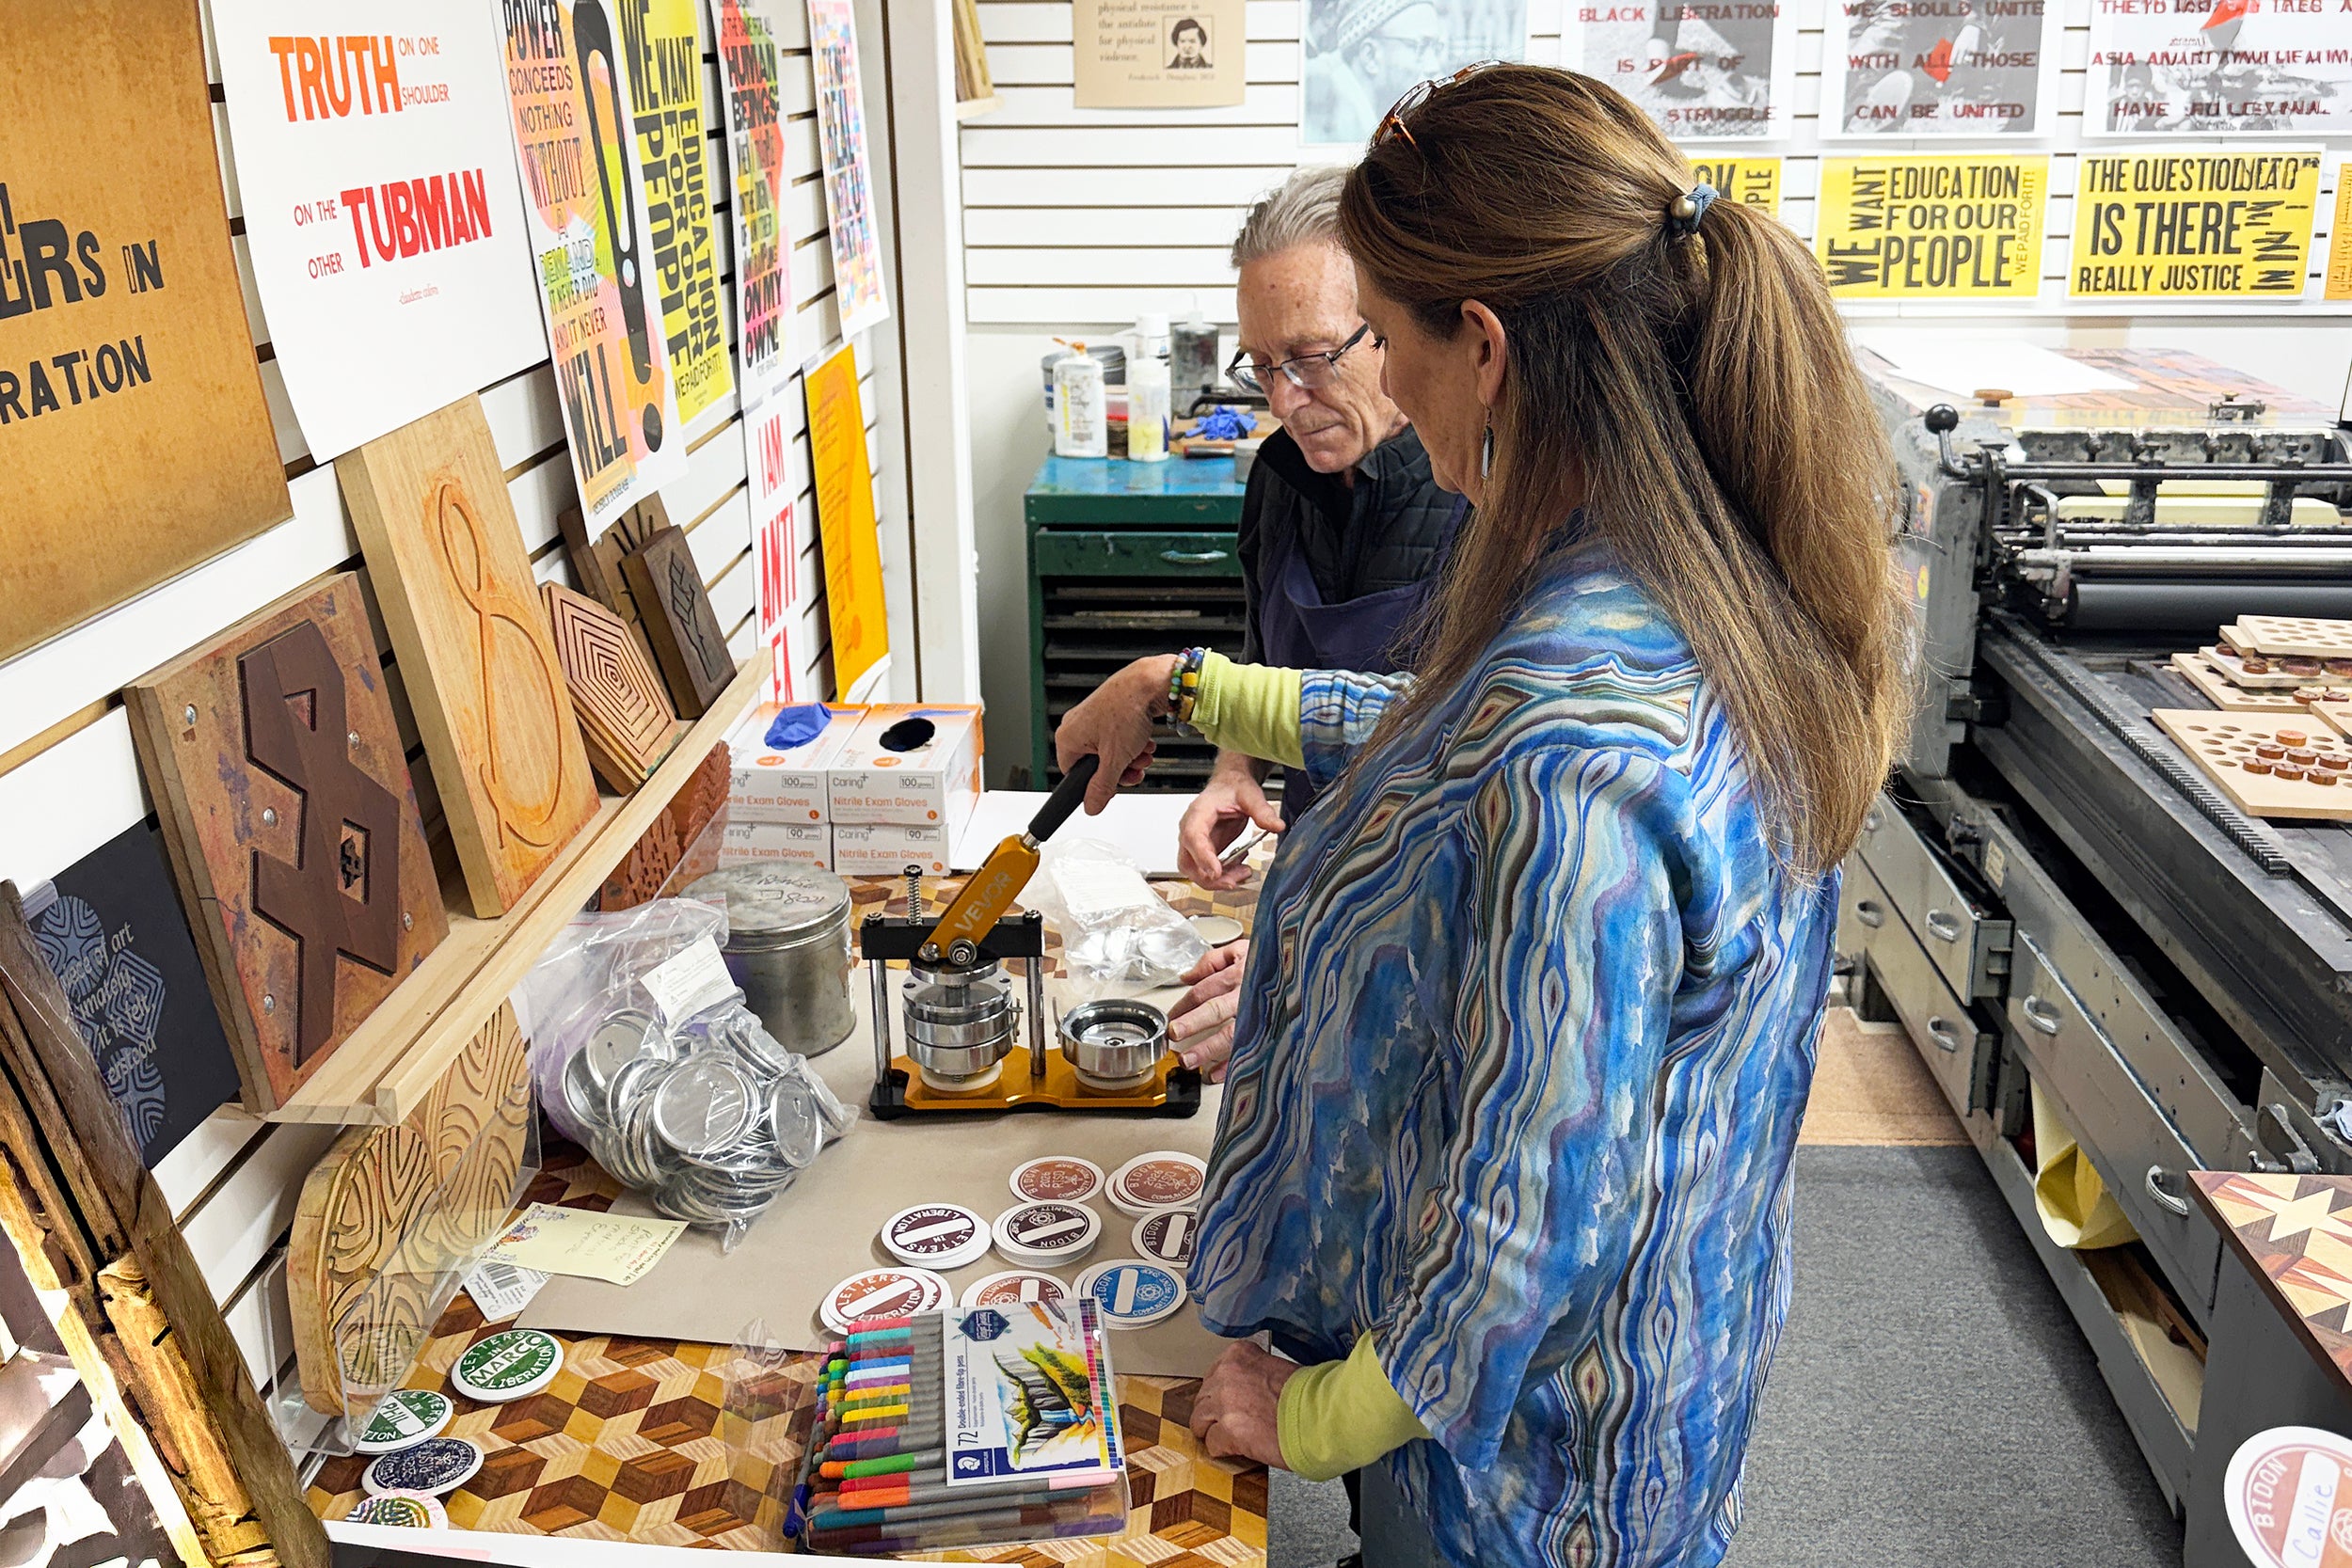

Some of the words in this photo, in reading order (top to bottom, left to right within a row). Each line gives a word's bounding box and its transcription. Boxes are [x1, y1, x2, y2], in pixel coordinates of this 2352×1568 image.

[1579, 6, 1645, 23] BLACK
[1660, 4, 1780, 21] LIBERATION
[1844, 2, 1875, 17] WE
[1890, 1, 1972, 17] SHOULD
[1985, 1, 2044, 16] UNITE
[503, 0, 565, 61] POWER
[399, 37, 415, 56] ON
[419, 37, 439, 56] ONE
[620, 0, 660, 113] WE
[656, 36, 695, 106] WANT
[1847, 54, 1899, 69] WITH
[1912, 53, 1955, 69] ALL
[1968, 52, 2036, 67] THOSE
[1617, 59, 1635, 72] IS
[1717, 55, 1745, 71] OF
[269, 36, 403, 122] TRUTH
[509, 65, 574, 96] CONCEEDS
[403, 84, 450, 105] SHOULDER
[1667, 106, 1776, 123] STRUGGLE
[1855, 104, 1897, 119] CAN
[1911, 104, 1938, 119] BE
[1953, 103, 2025, 119] UNITED
[2114, 103, 2169, 117] HAVE
[1889, 166, 2020, 199] EDUCATION
[2088, 159, 2129, 192] THE
[1850, 166, 1886, 231] WANT
[2023, 190, 2033, 220] FOR
[294, 203, 313, 227] ON
[317, 198, 338, 222] THE
[342, 167, 492, 268] TUBMAN
[679, 108, 721, 351] EDUCATION
[1886, 204, 1948, 231] FOR
[1955, 204, 2018, 230] OUR
[2090, 201, 2125, 256] IS
[2135, 200, 2247, 256] THERE
[2019, 221, 2030, 252] PAID
[122, 240, 165, 293] IN
[308, 251, 344, 279] OTHER
[1827, 238, 1881, 287] WE
[1881, 235, 2016, 288] PEOPLE
[2015, 254, 2028, 275] WE
[2078, 264, 2154, 293] REALLY
[2160, 264, 2244, 291] JUSTICE
[556, 279, 581, 313] NEVER
[744, 281, 763, 324] ON
[762, 267, 783, 315] MY
[579, 307, 607, 340] NEVER
[757, 427, 767, 499] I
[765, 414, 786, 496] AM
[761, 501, 797, 635] ANTI
[784, 777, 800, 786] 100
[901, 778, 917, 787] 100
[747, 796, 774, 806] Exam
[776, 796, 810, 806] Gloves
[834, 797, 863, 806] Nitrile
[866, 797, 893, 807] Exam
[895, 797, 928, 807] Gloves
[910, 831, 921, 839] 90
[752, 847, 780, 857] Exam
[782, 847, 815, 858] Gloves
[838, 849, 867, 859] Nitrile
[870, 849, 898, 859] Exam
[900, 849, 933, 860] Gloves
[954, 871, 1014, 931] VEVOR
[111, 922, 135, 953] art
[110, 1013, 125, 1037] is
[1129, 1164, 1155, 1188] BIDON
[895, 1209, 961, 1233] LIBERATION
[1146, 1221, 1163, 1246] BIDON
[907, 1229, 974, 1253] LETTERS
[1041, 1232, 1080, 1247] BIDON
[837, 1275, 901, 1307] LETTERS
[863, 1286, 877, 1294] IN
[857, 1290, 921, 1322] LIBERATION
[462, 1331, 526, 1376] LETTERS
[469, 1335, 543, 1386] MARCO
[487, 1347, 502, 1357] IN
[487, 1344, 553, 1388] LIBERATION
[956, 1369, 965, 1391] fibre-tip
[380, 1402, 410, 1427] PHIL
[957, 1390, 966, 1429] Double-ended
[958, 1431, 978, 1446] 72
[2252, 1456, 2288, 1528] BIDON
[2292, 1484, 2333, 1560] Callie
